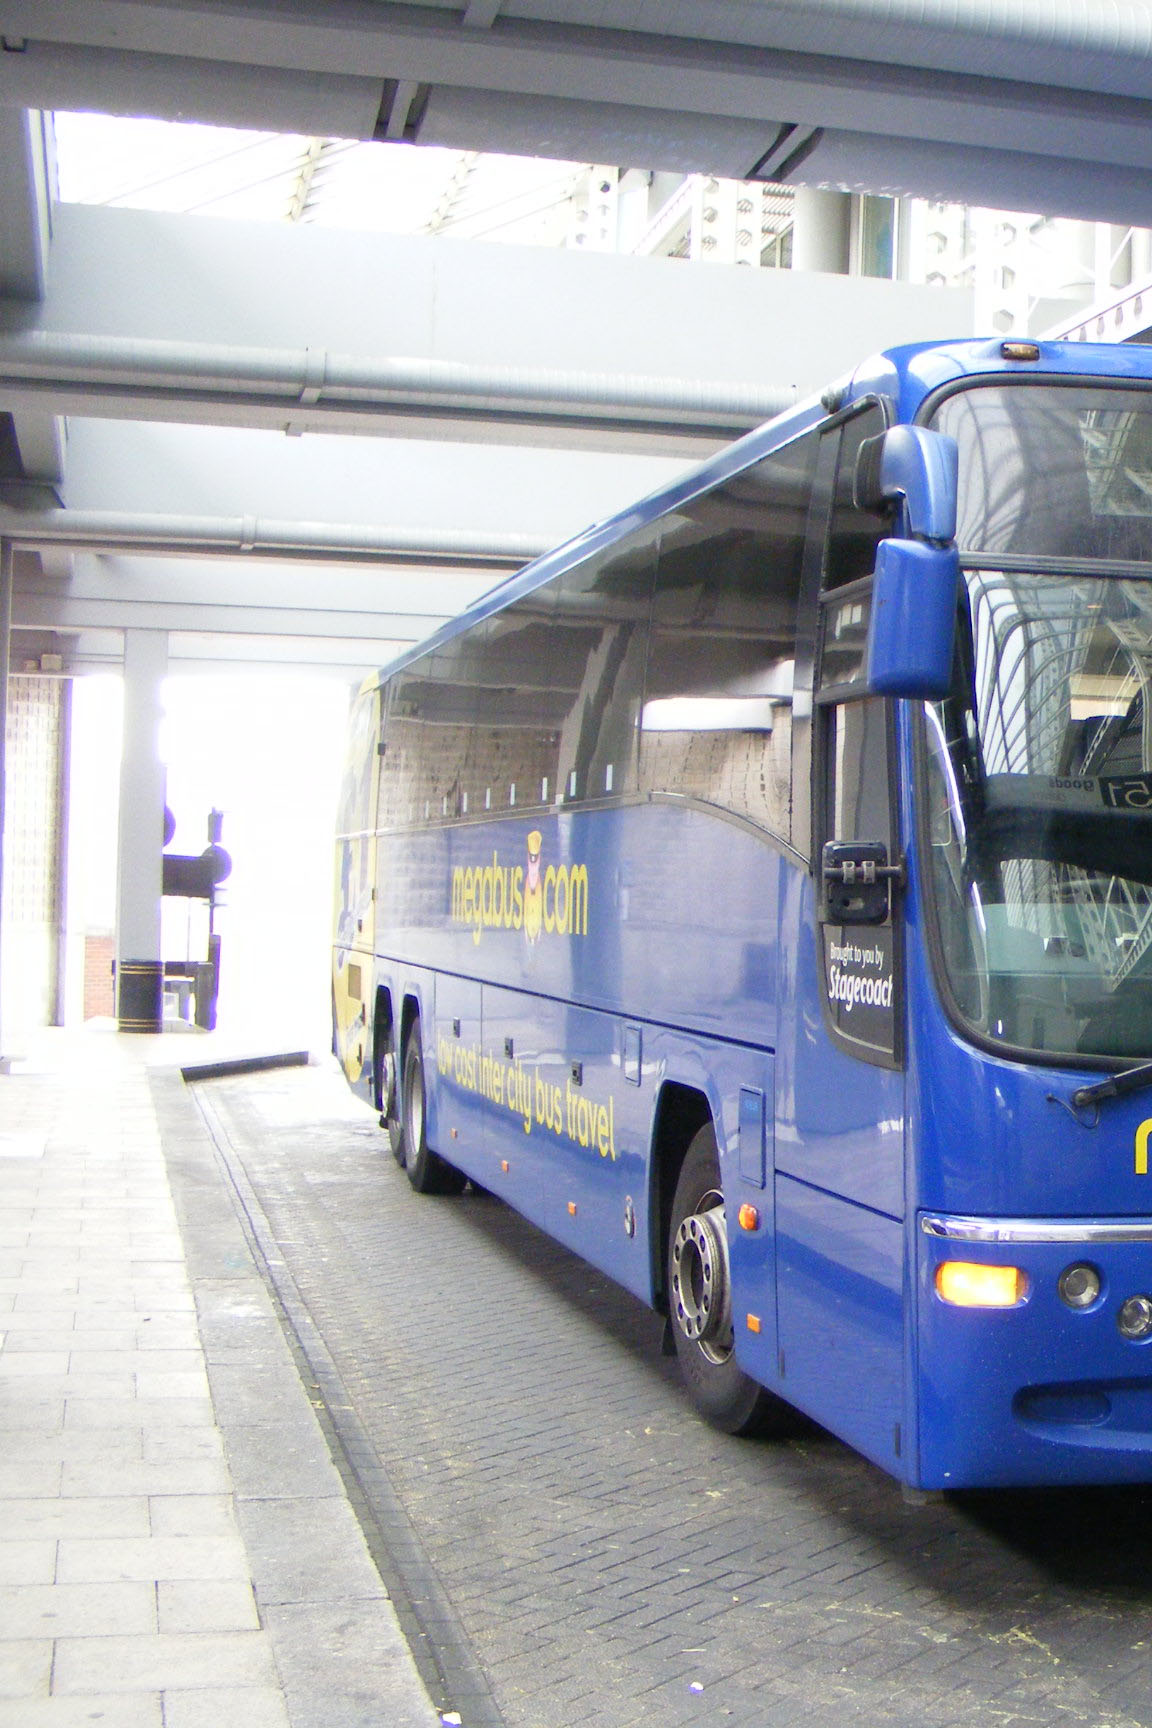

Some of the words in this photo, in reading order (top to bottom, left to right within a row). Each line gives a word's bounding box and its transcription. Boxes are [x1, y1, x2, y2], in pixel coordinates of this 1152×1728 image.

[455, 1043, 477, 1092] cost
[479, 1043, 505, 1105] inter
[507, 1054, 532, 1135] city
[535, 1066, 562, 1136] bus
[566, 1078, 616, 1162] travel
